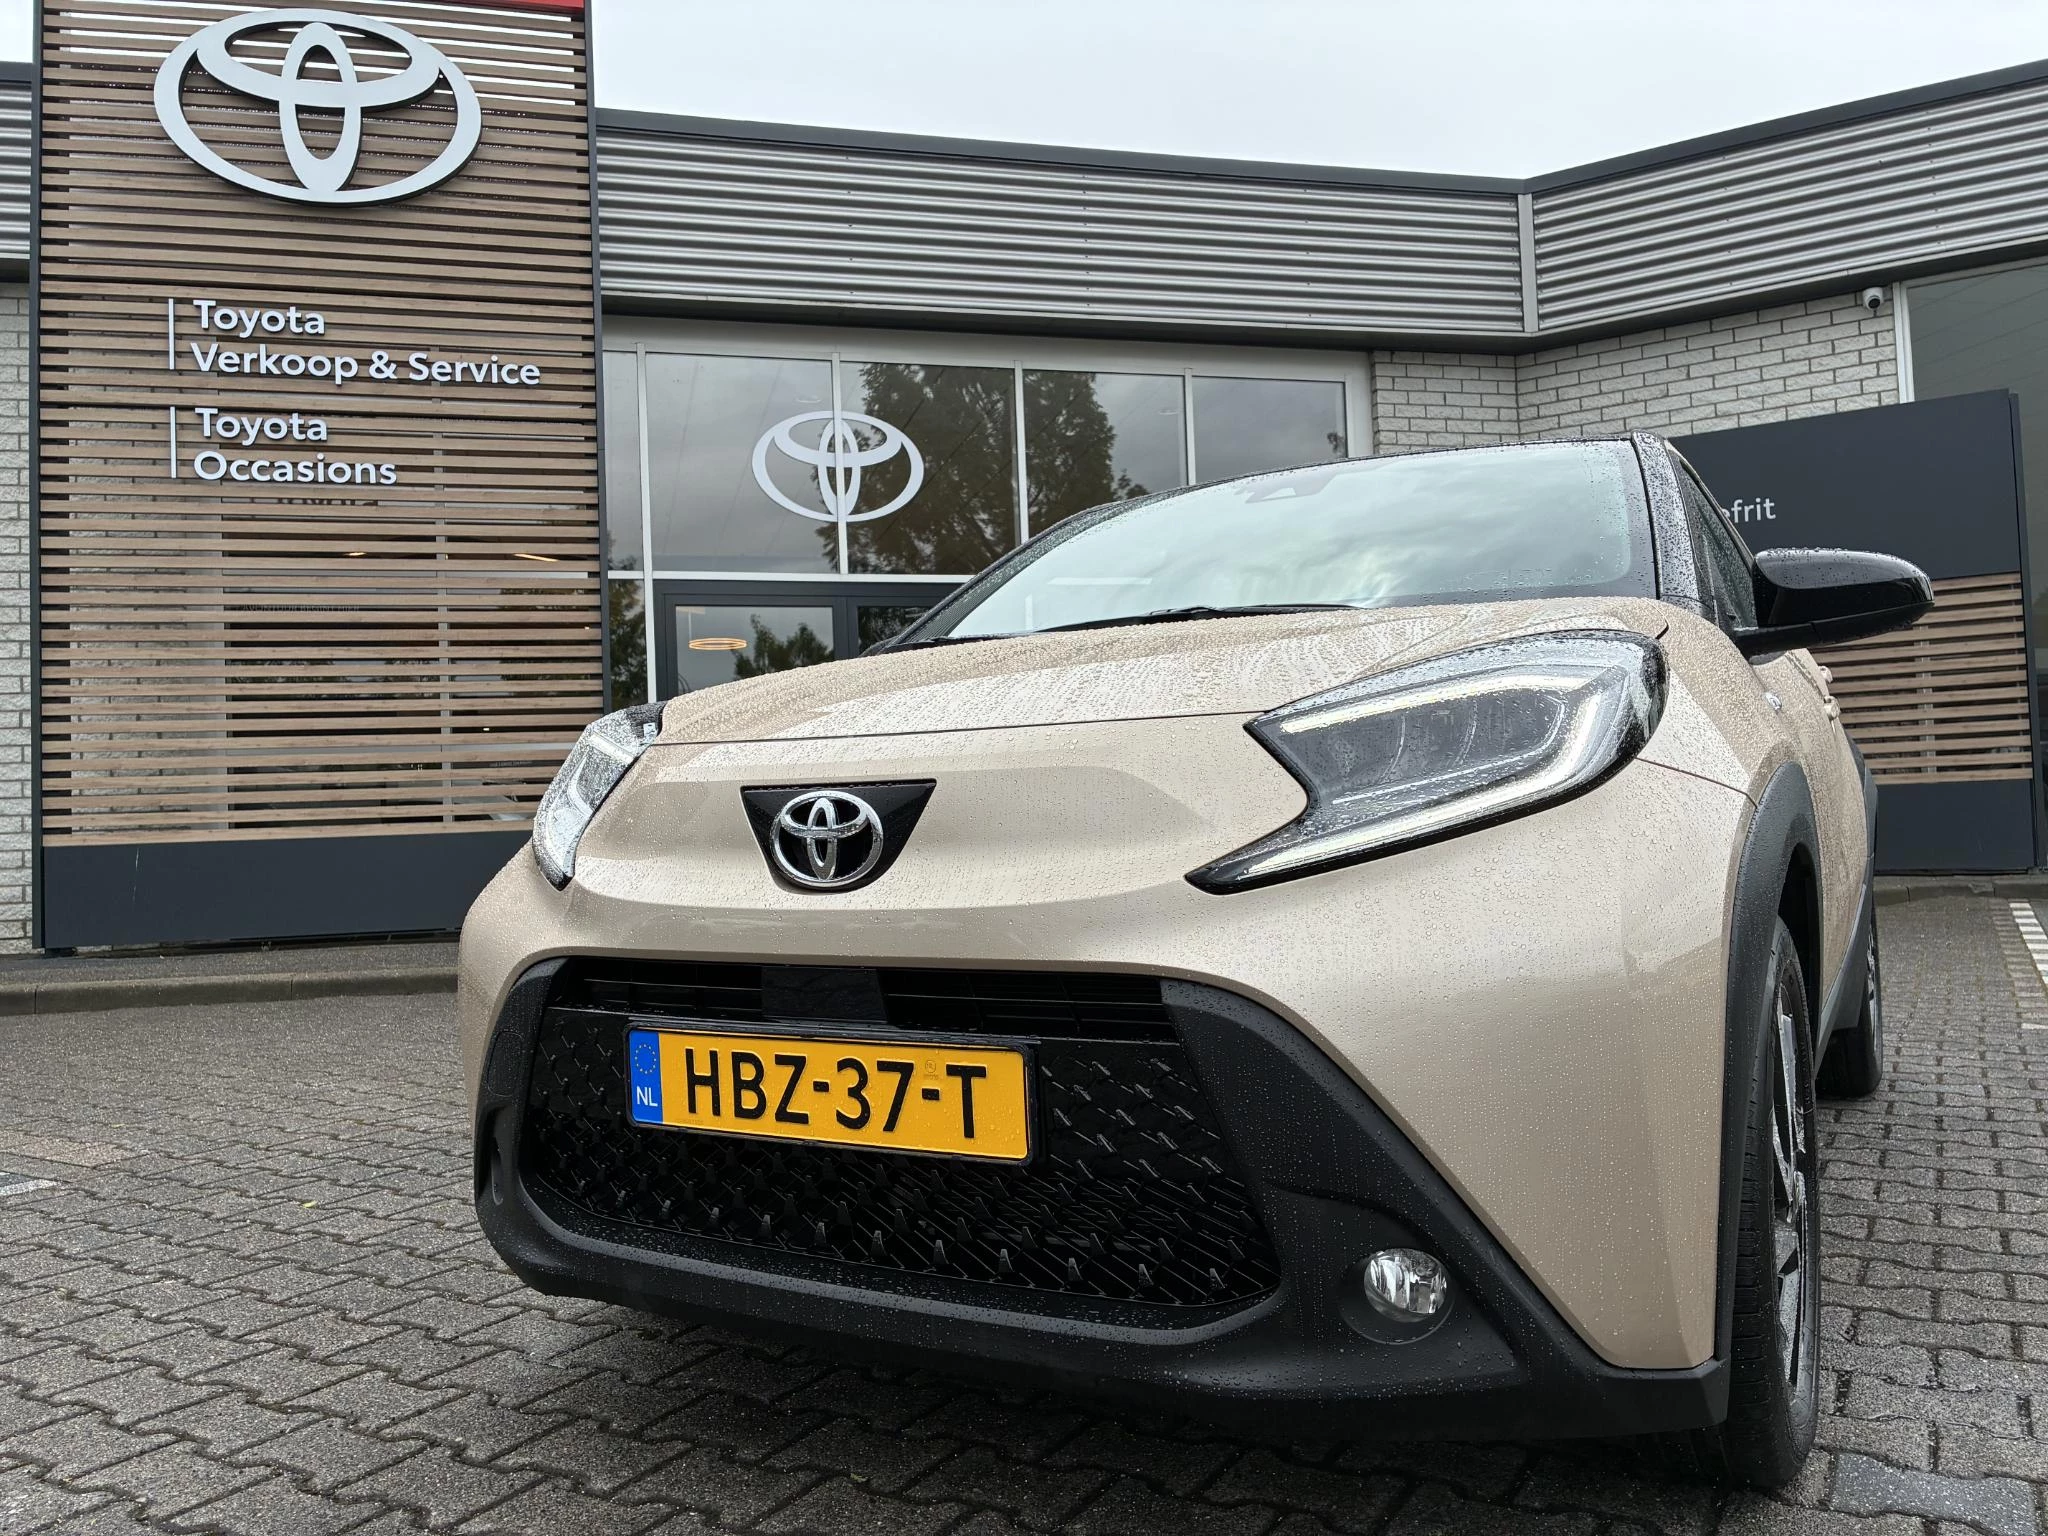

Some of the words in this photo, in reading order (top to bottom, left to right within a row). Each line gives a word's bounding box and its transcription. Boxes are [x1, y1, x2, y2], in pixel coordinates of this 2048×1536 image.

[193, 299, 325, 338] Toyota
[190, 342, 359, 385] Verkoop
[368, 350, 397, 380] &
[408, 352, 541, 385] Service
[194, 407, 328, 446] Toyota
[193, 450, 397, 485] Occasions
[636, 1085, 658, 1107] NL
[685, 1048, 987, 1138] HBZ-37-T
